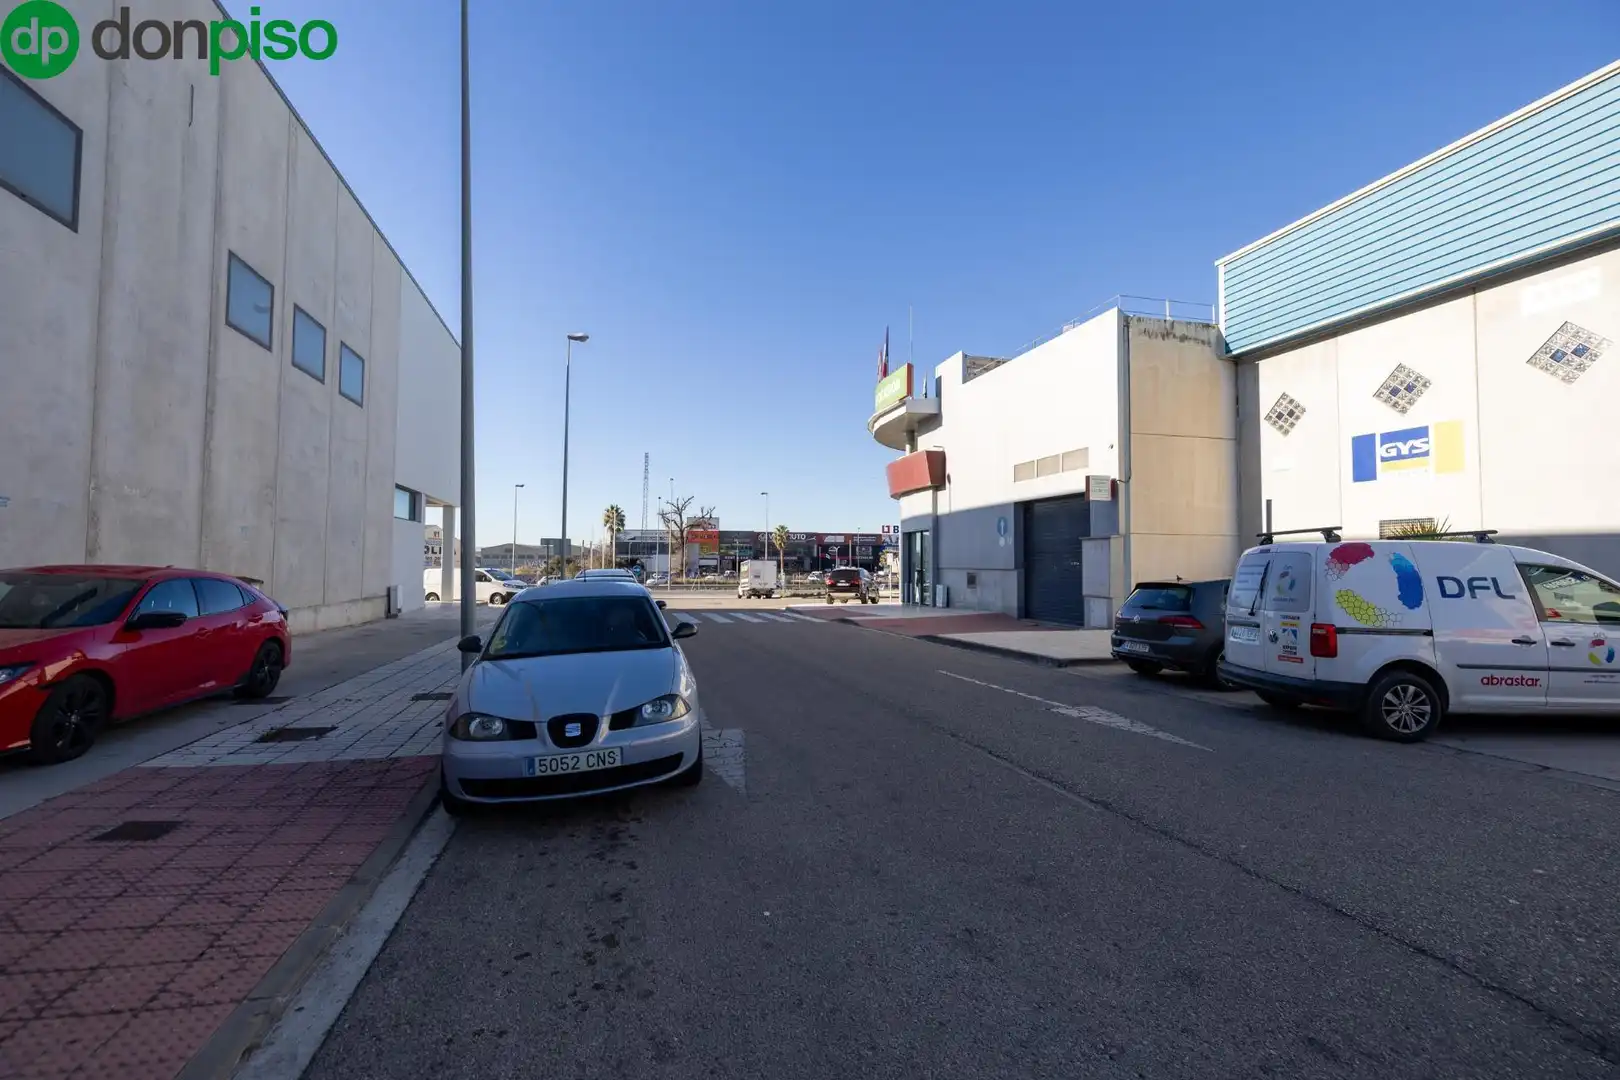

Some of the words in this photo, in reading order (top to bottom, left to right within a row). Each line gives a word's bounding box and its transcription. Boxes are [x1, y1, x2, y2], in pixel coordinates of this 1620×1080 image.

[1380, 437, 1429, 457] GYS
[1436, 576, 1515, 599] DFL
[538, 757, 581, 773] 5052
[586, 750, 617, 768] CNS
